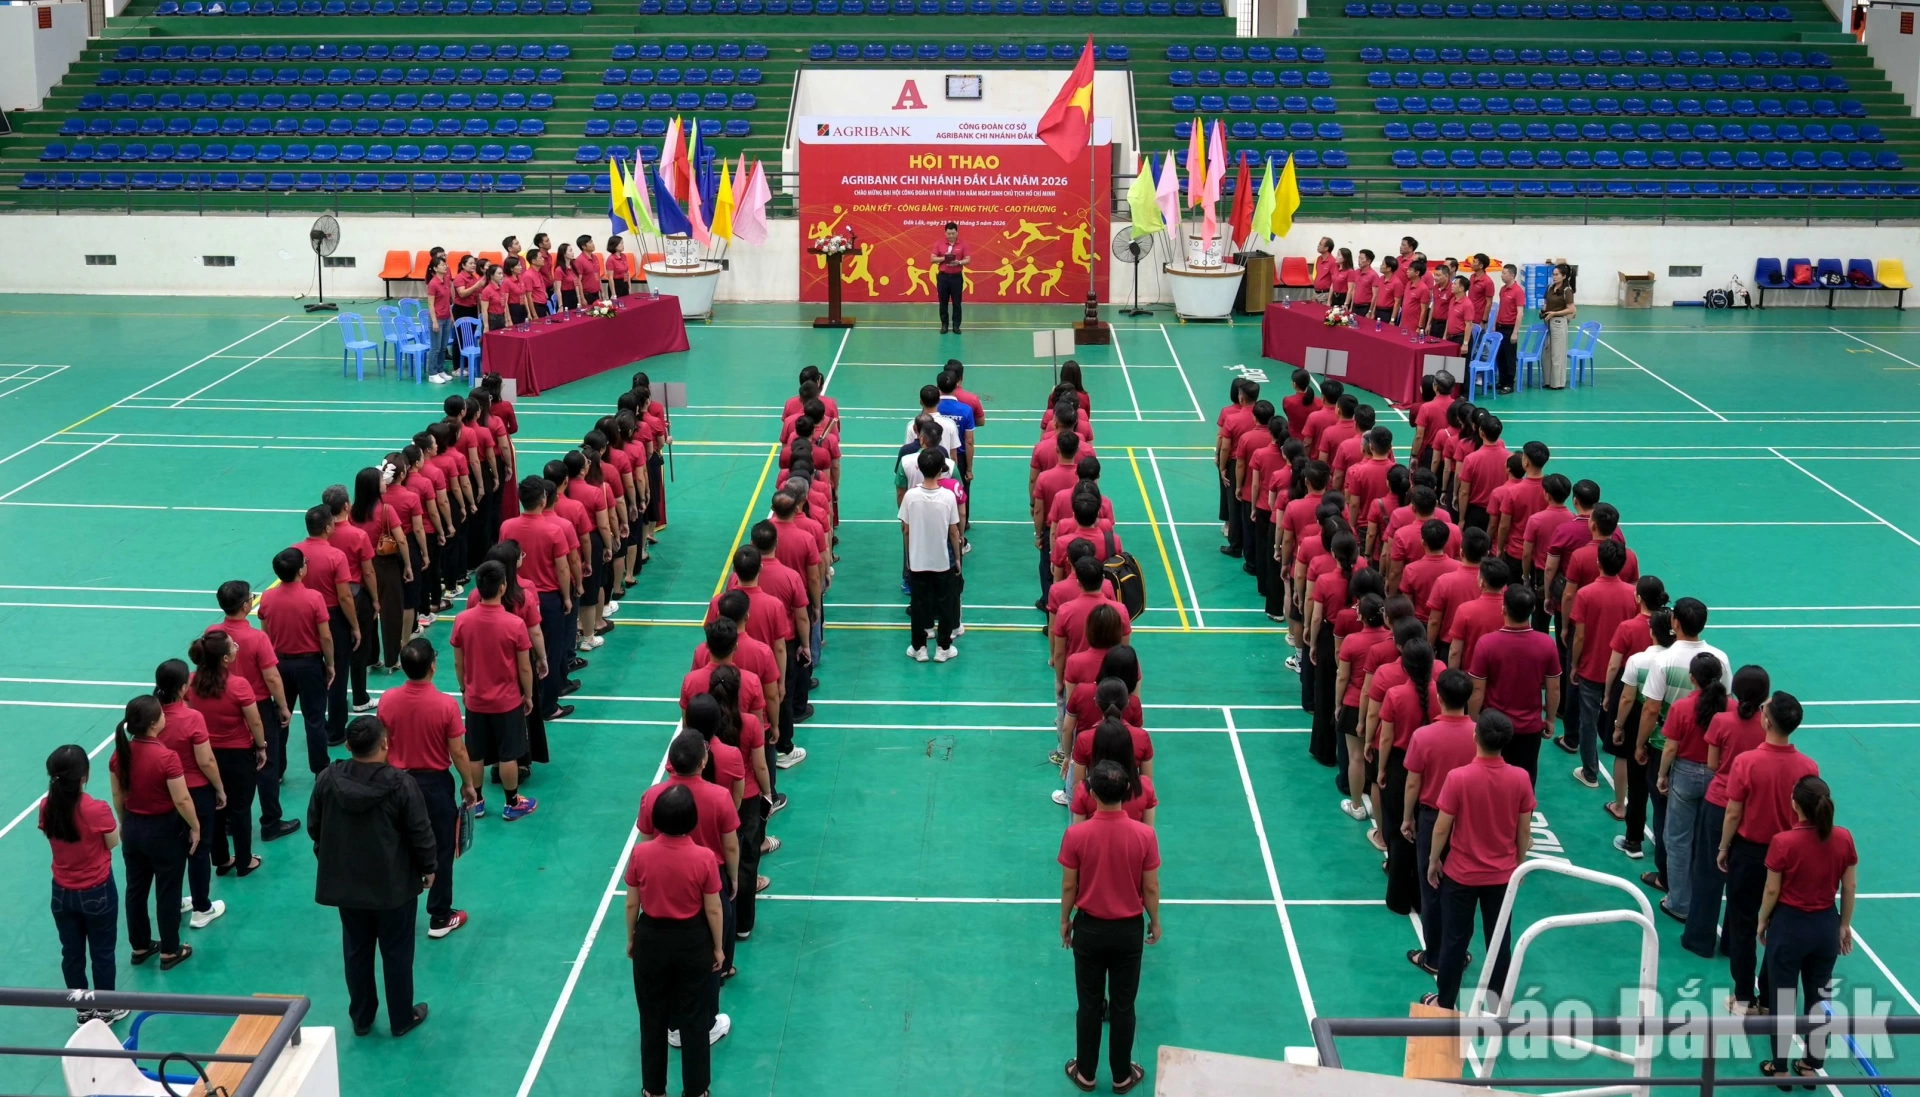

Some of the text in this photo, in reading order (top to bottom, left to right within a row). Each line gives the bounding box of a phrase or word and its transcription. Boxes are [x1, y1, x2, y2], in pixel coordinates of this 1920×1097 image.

[892, 80, 927, 110] A
[833, 126, 911, 137] AGRIBANK
[958, 122, 980, 130] CÔNG
[981, 122, 1003, 130] ĐOÀN
[1016, 122, 1027, 130] SỞ
[989, 131, 1016, 139] NHÁNH
[909, 152, 1000, 171] HỘI THAO
[841, 173, 1068, 186] AGRIBANK CHI NHÁNH ĐẮK LẮK NĂM 2026
[852, 203, 877, 212] ĐOÀN
[877, 203, 892, 212] KẾT
[897, 204, 920, 212] CÔNG
[921, 203, 943, 212] BẰNG
[949, 205, 976, 213] TRUNG
[977, 204, 999, 214] THỰC
[1022, 205, 1057, 214] THƯỢNG
[960, 219, 976, 227] tháng
